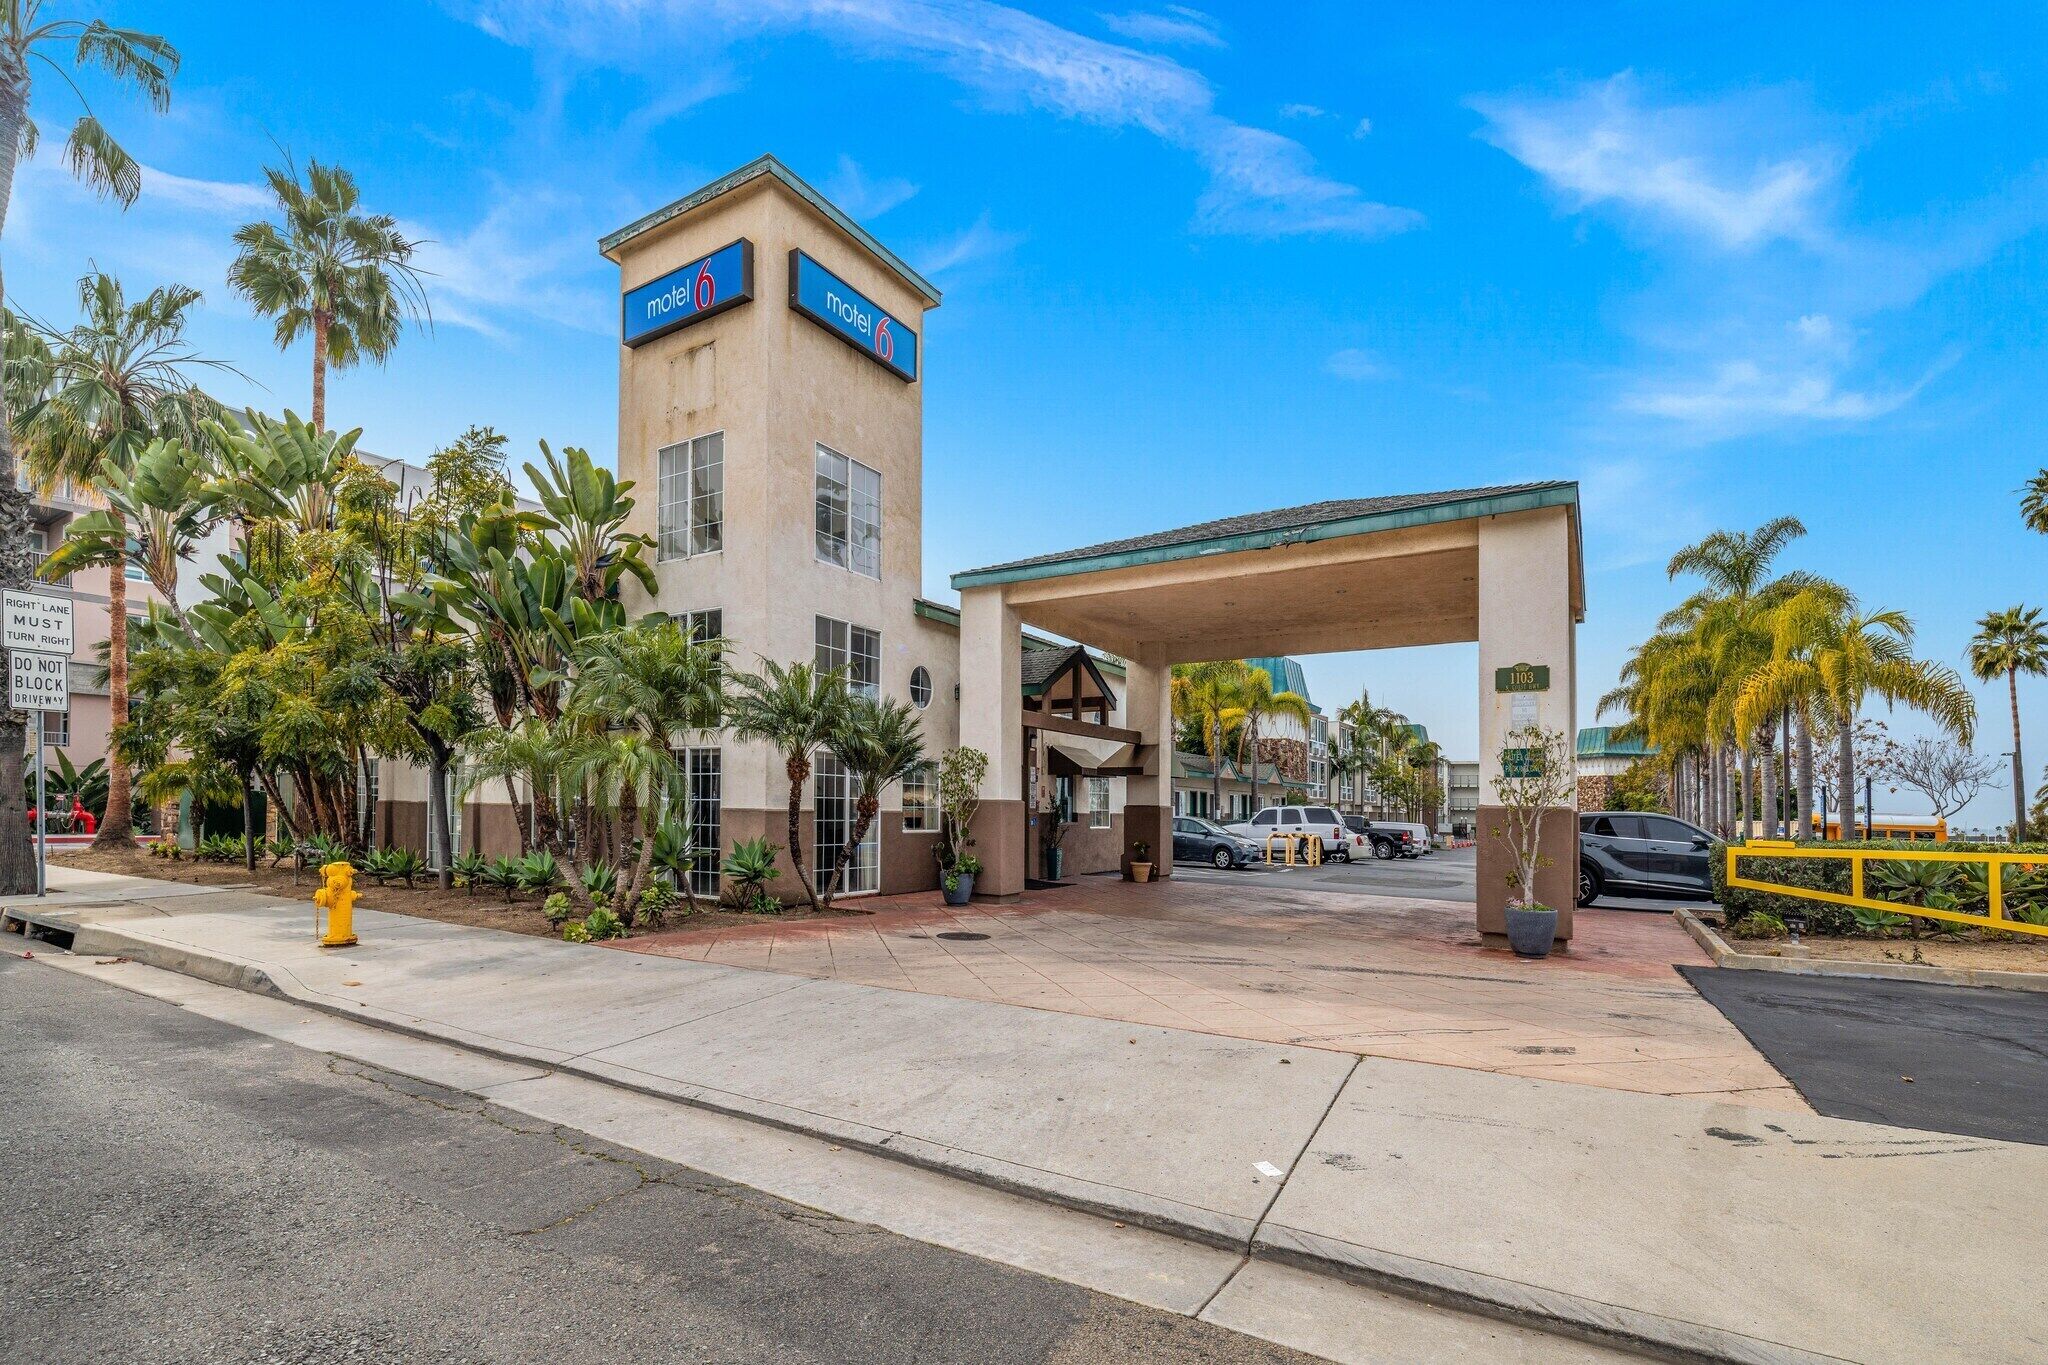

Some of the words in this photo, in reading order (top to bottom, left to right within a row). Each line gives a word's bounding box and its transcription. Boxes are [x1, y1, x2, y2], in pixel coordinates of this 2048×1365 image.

[647, 278, 690, 319] motel
[694, 257, 716, 311] 6
[826, 290, 871, 337] motel
[874, 316, 894, 362] 6
[6, 598, 36, 610] RIGHT
[42, 603, 70, 615] LANE
[14, 615, 63, 630] MUST
[6, 630, 35, 642] TURN
[41, 635, 71, 646] RIGHT
[14, 657, 32, 671] DO
[38, 660, 63, 674] NOT
[15, 675, 64, 692] BLOCK
[1510, 671, 1534, 684] 1103
[14, 693, 64, 705] DRIVEWAY
